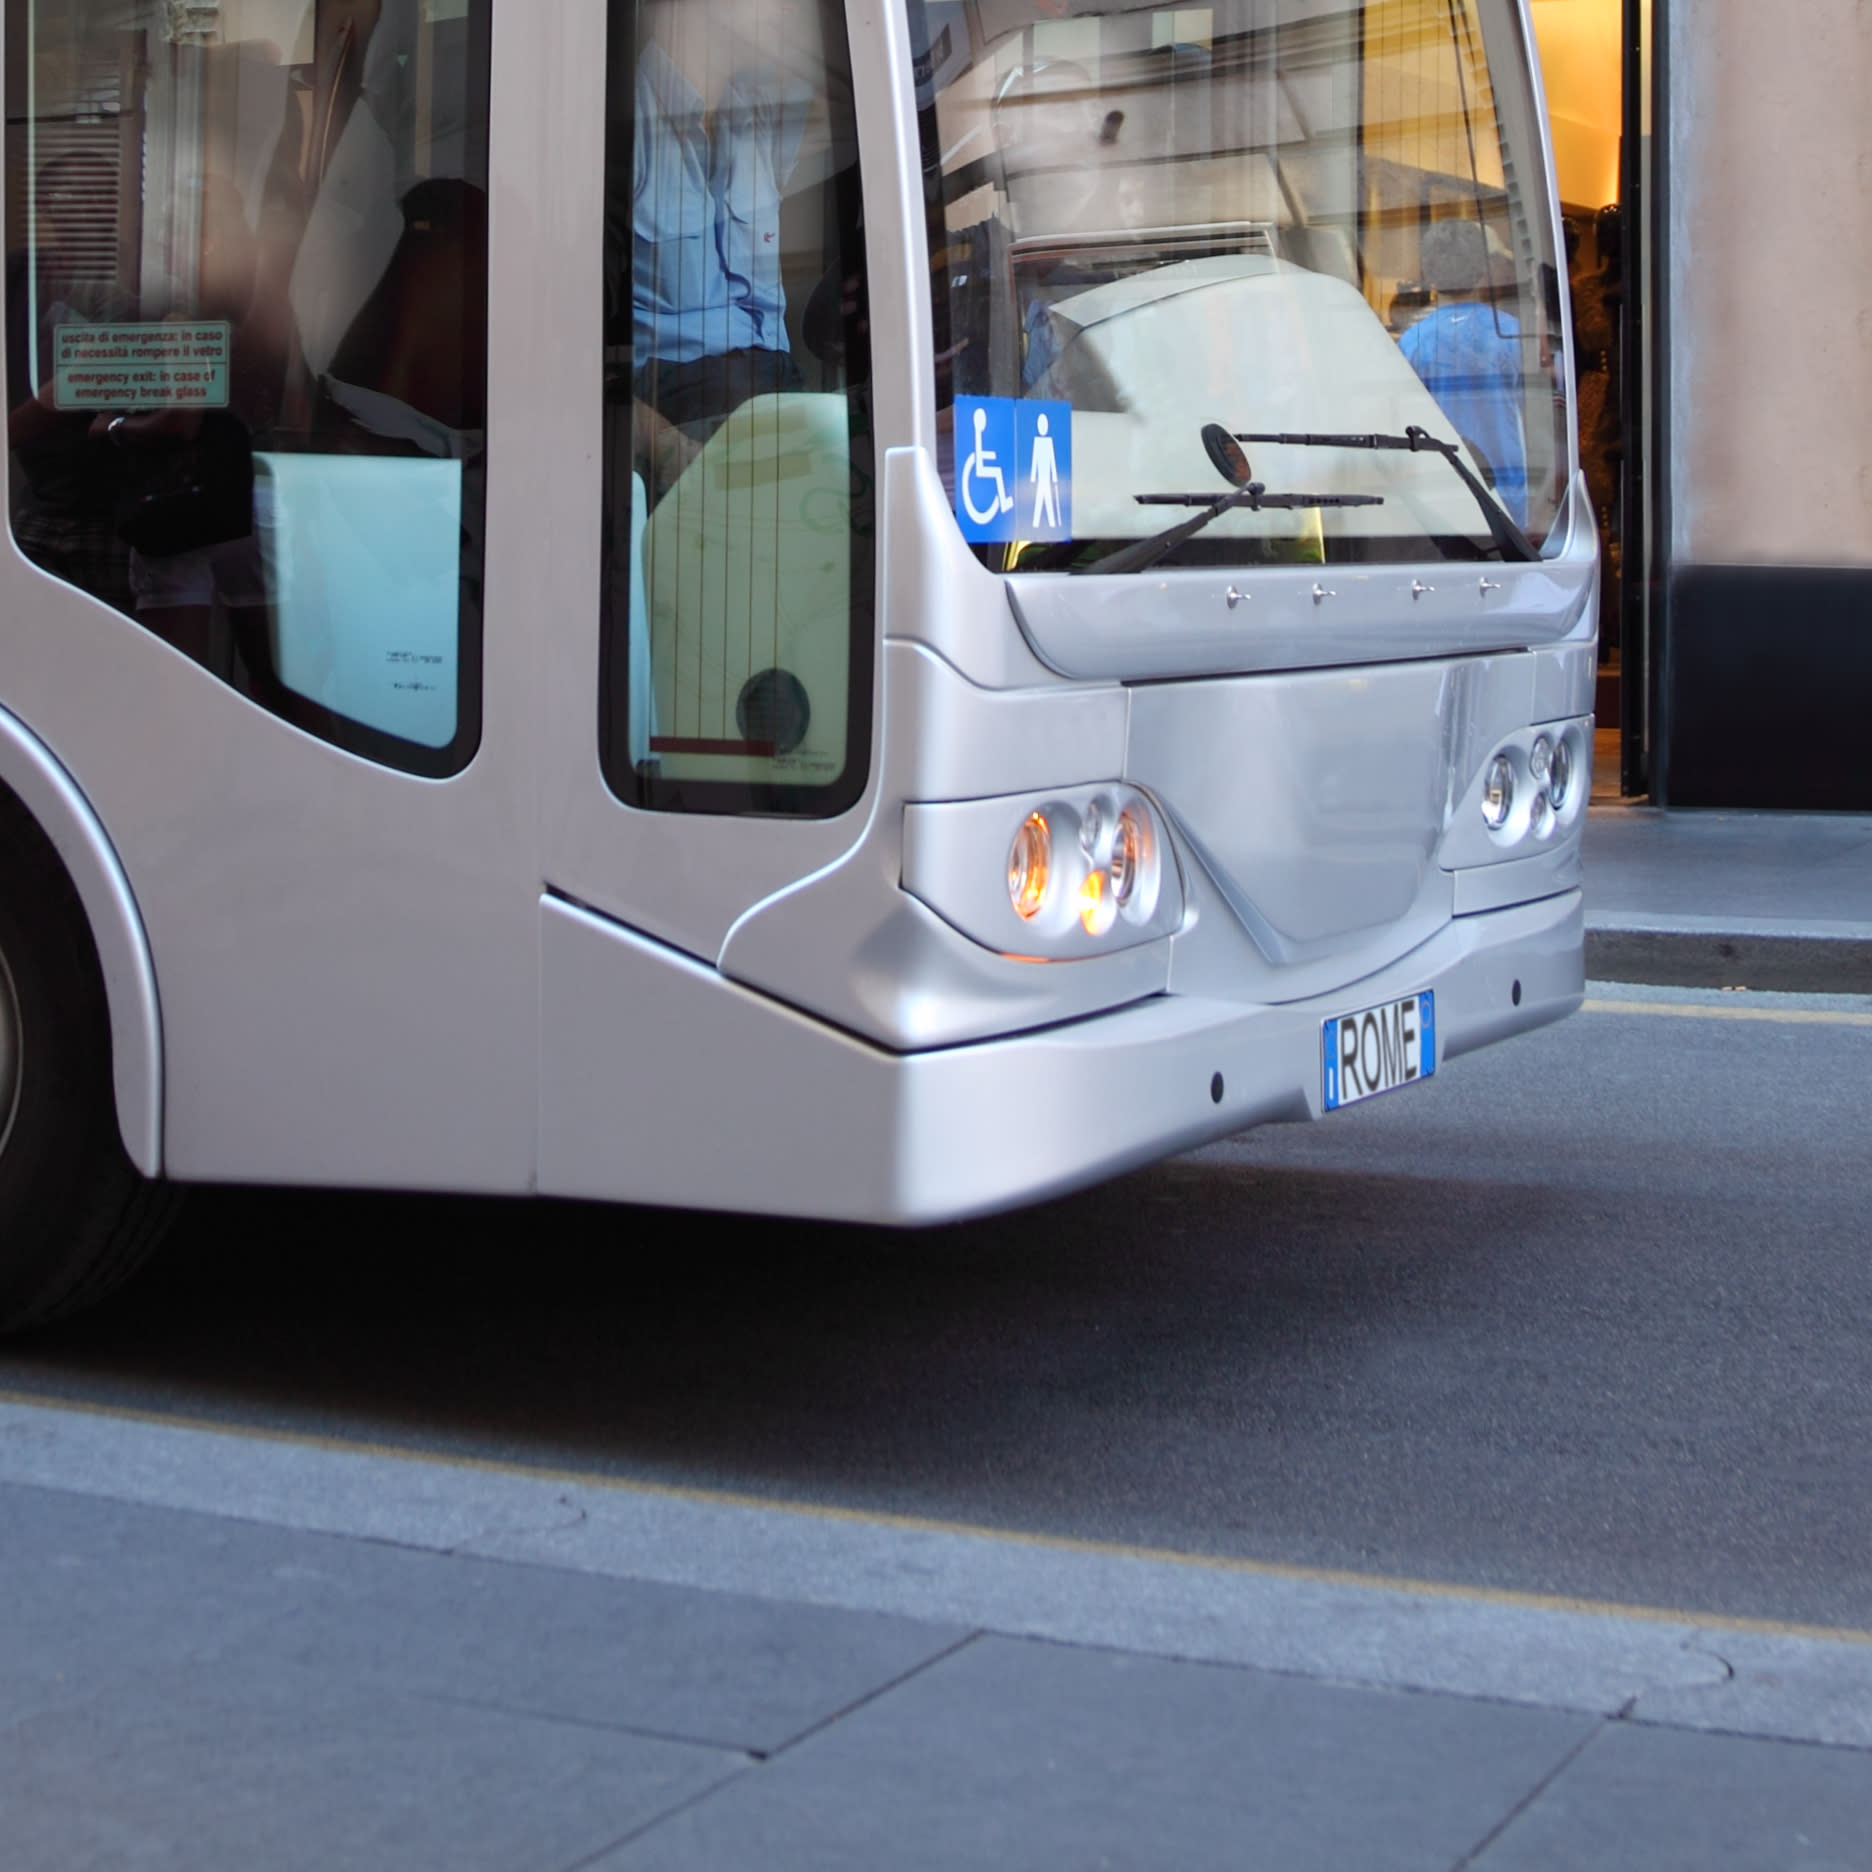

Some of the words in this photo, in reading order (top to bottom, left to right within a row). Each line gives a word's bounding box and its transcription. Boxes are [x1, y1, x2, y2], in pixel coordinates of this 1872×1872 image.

[61, 332, 95, 343] uscita
[98, 330, 109, 343] di
[112, 332, 177, 344] emergenza:
[181, 330, 192, 341] in
[195, 330, 223, 341] caso
[61, 346, 72, 359] di
[131, 346, 179, 360] rompere
[183, 344, 190, 357] il
[193, 345, 223, 357] vetro
[68, 372, 129, 385] emergency
[160, 370, 170, 382] in
[173, 371, 200, 382] case
[203, 369, 216, 382] of
[75, 387, 137, 400] emergency
[140, 385, 172, 398] break
[176, 385, 207, 400] glass
[1340, 998, 1418, 1101] ROME
